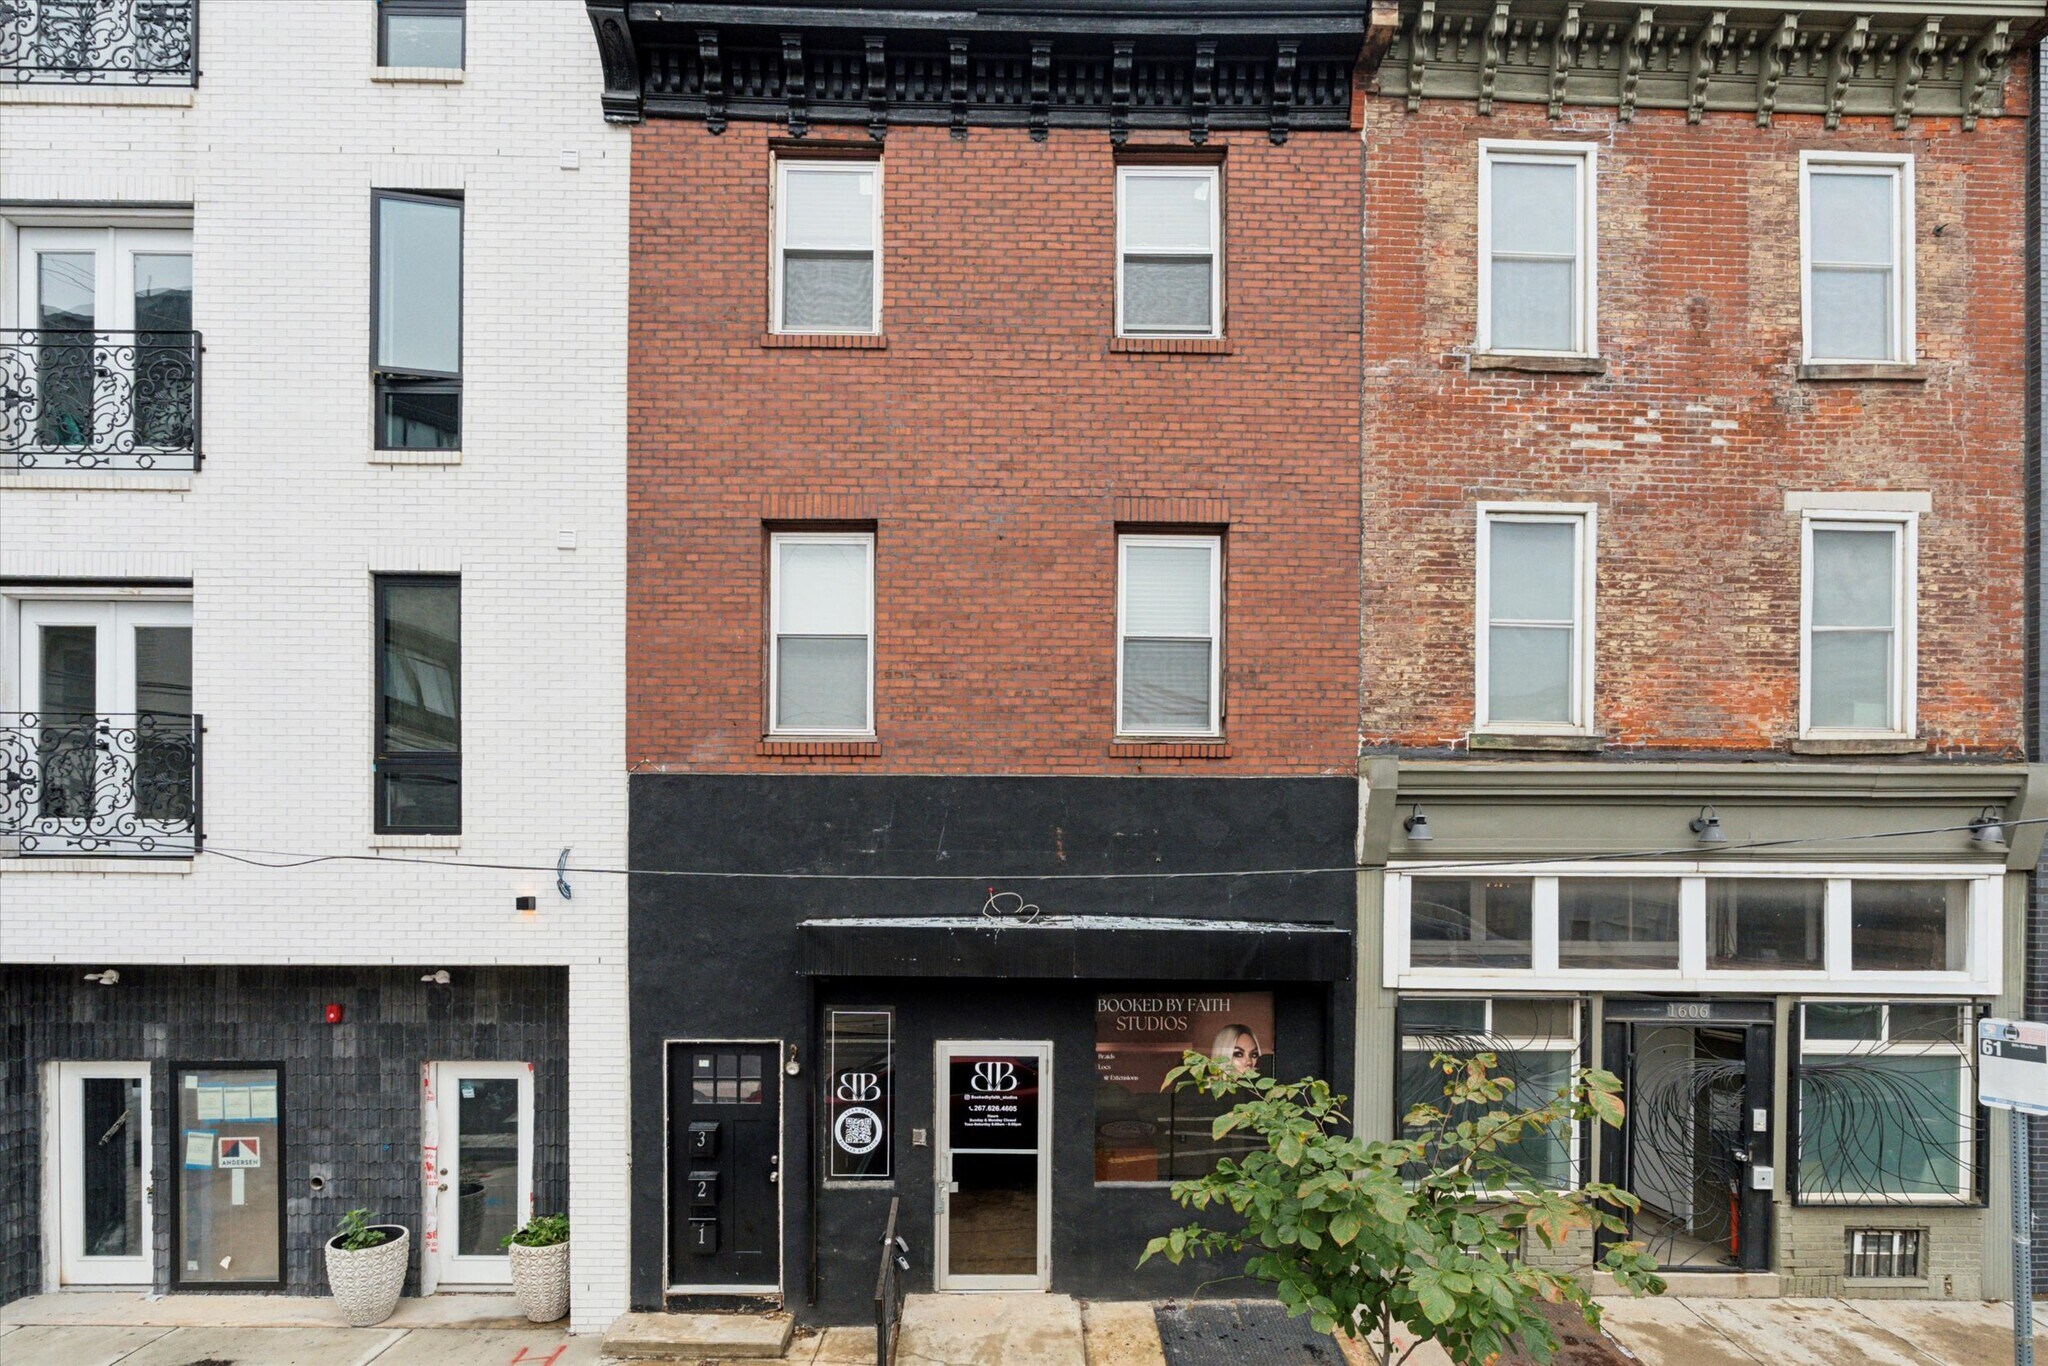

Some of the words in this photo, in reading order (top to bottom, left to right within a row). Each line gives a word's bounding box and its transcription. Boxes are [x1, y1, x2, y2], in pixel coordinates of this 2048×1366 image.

[1098, 998, 1163, 1013] BOOKED
[1166, 999, 1185, 1012] BY
[1188, 999, 1230, 1012] FAITH
[1667, 1003, 1708, 1018] 1606
[1116, 1015, 1188, 1031] STUDIOS
[1982, 1039, 2002, 1057] 61
[697, 1131, 706, 1147] 3
[697, 1181, 707, 1198] 2
[698, 1224, 705, 1244] 1
